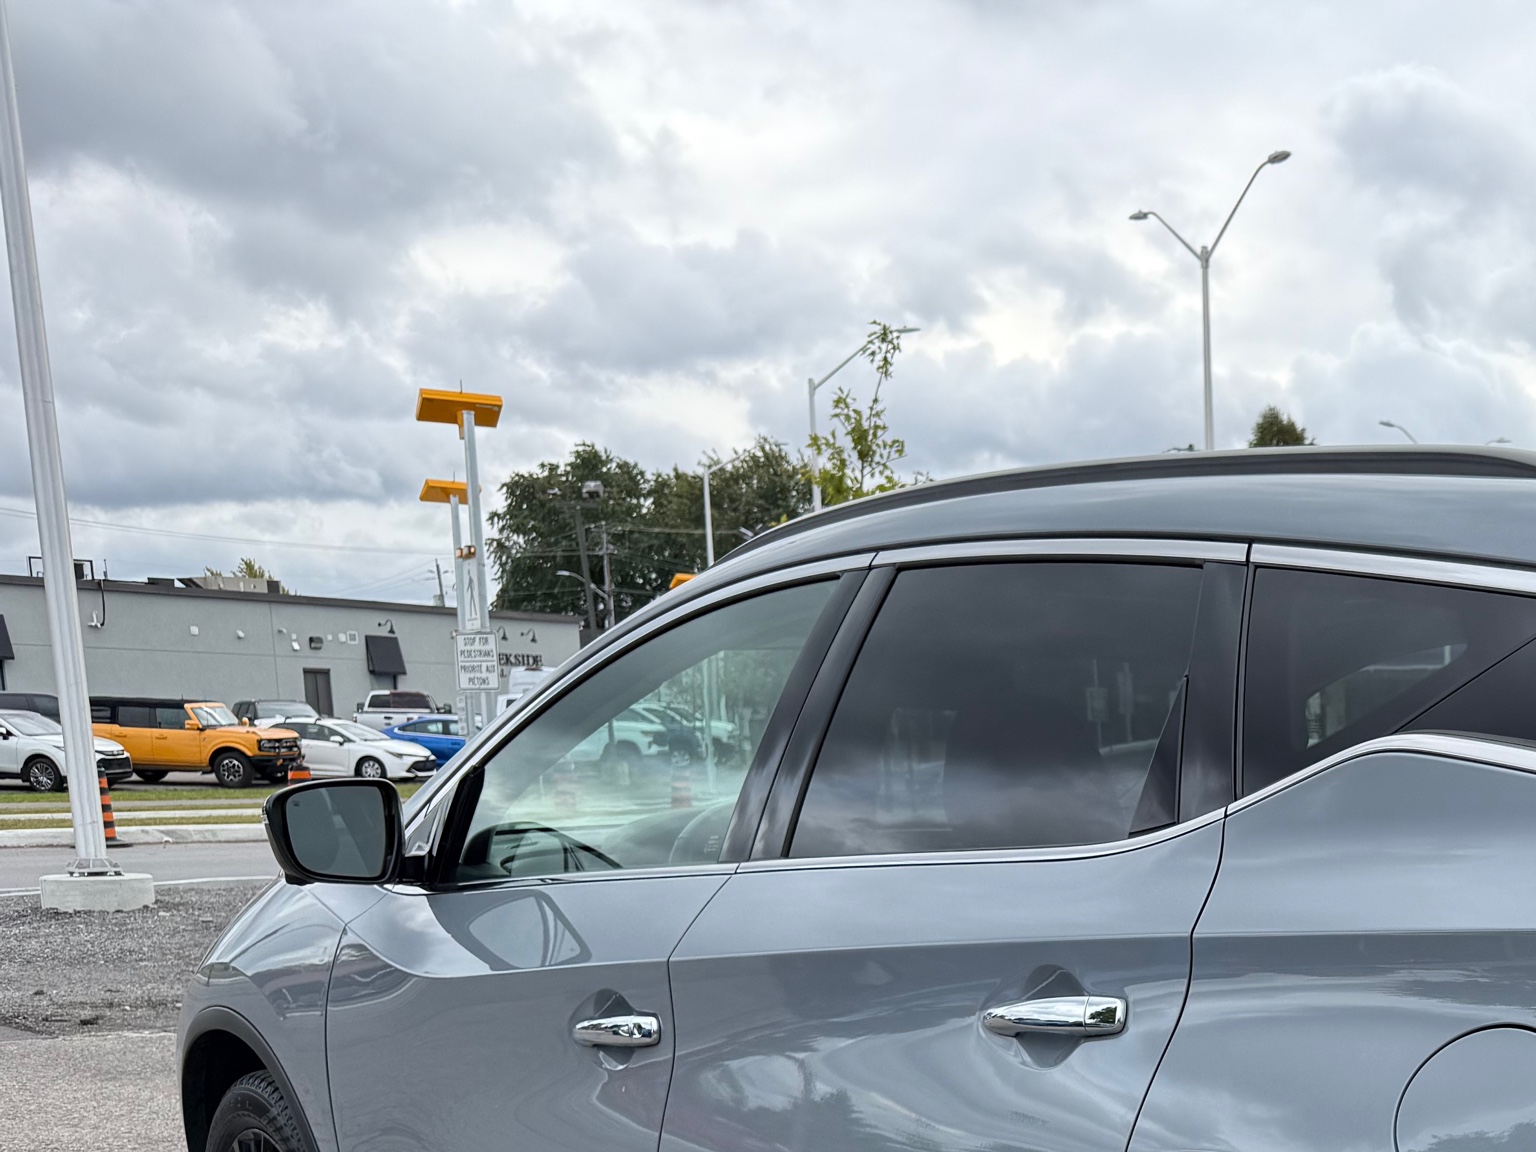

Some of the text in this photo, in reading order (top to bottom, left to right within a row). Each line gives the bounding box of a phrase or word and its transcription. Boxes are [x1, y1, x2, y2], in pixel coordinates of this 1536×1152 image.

[463, 636, 489, 647] STOP FOR
[460, 648, 495, 659] PEDESTRIANS
[498, 652, 544, 667] EKSIDE
